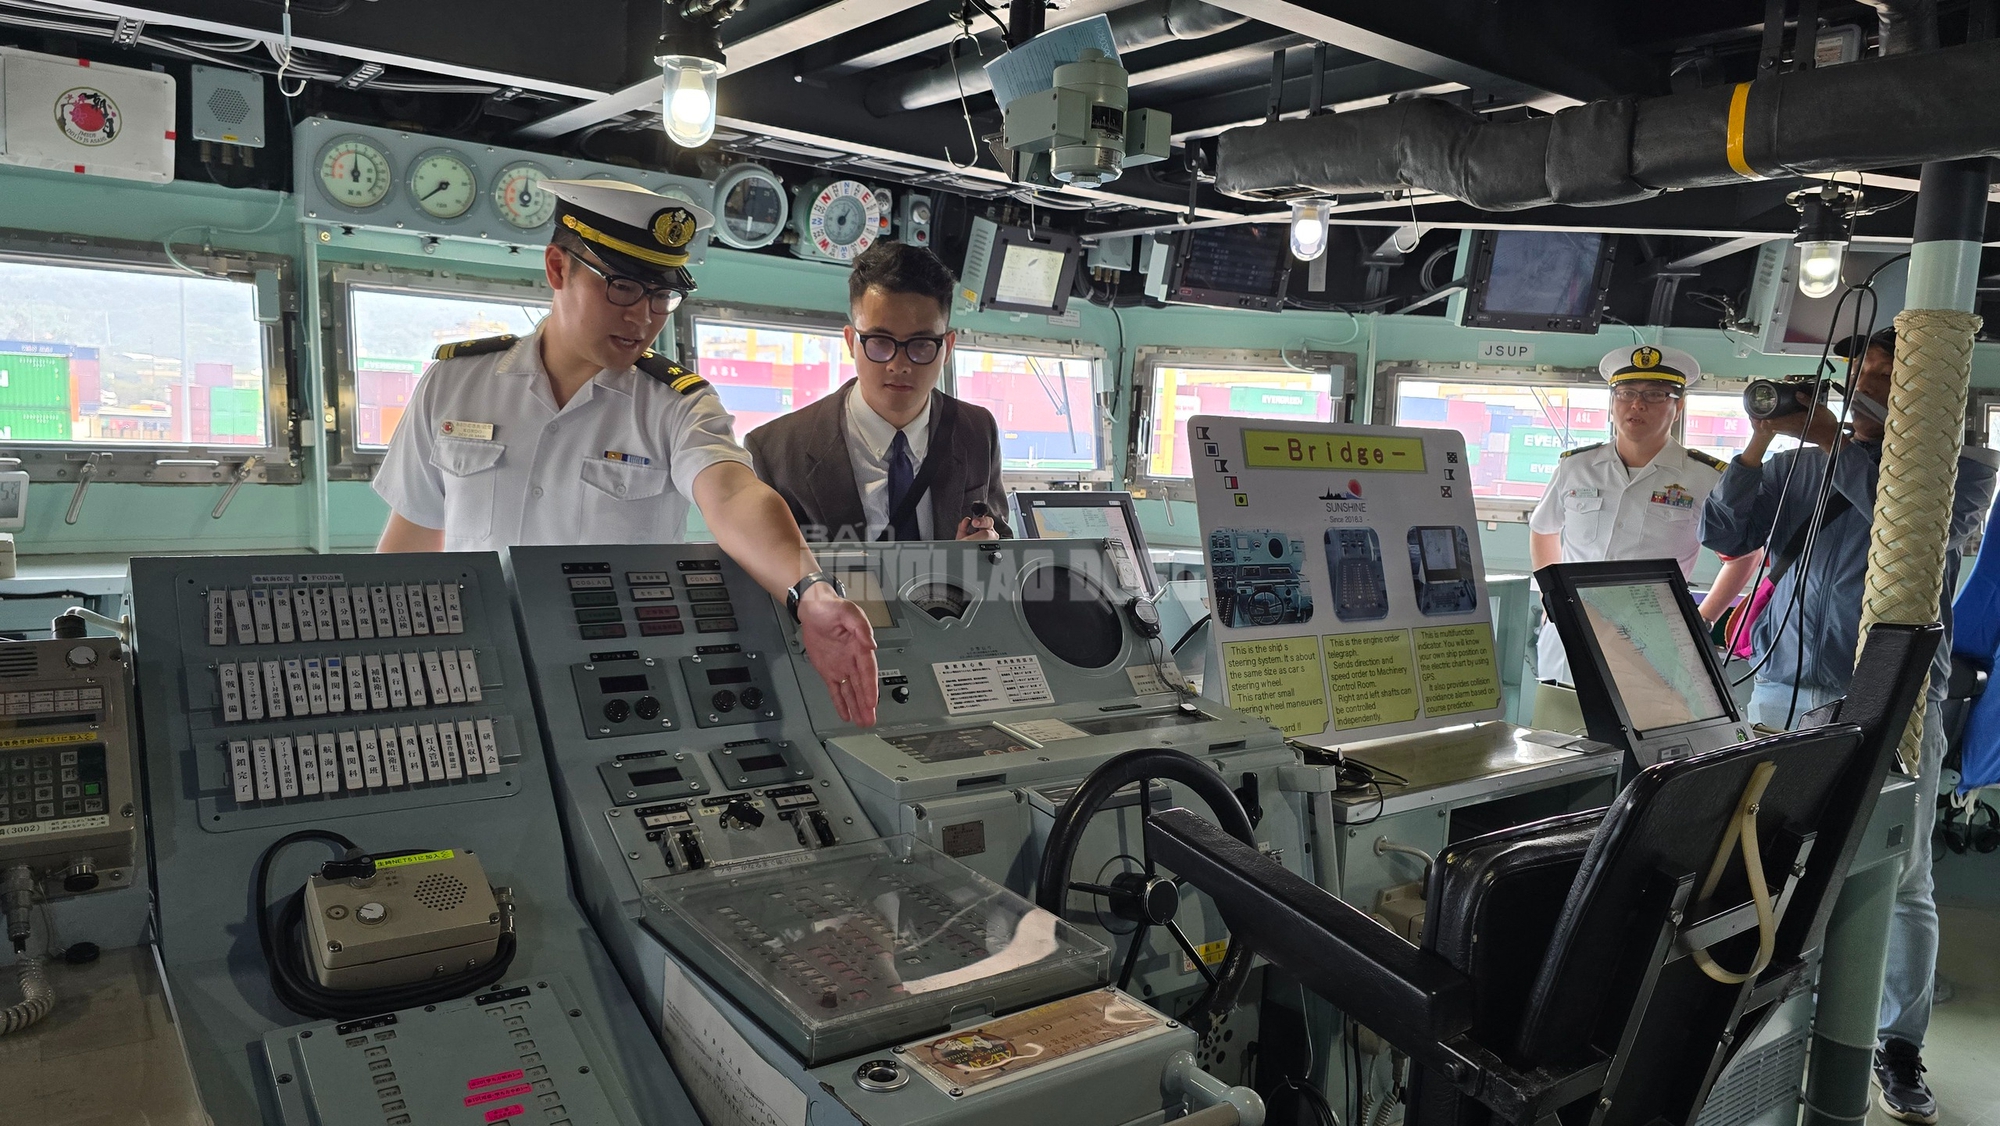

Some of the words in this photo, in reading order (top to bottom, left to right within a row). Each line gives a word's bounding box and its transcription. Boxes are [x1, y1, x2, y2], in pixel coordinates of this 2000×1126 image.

[820, 192, 831, 204] N
[861, 191, 871, 203] E
[818, 238, 830, 251] W
[859, 237, 869, 247] S
[1485, 345, 1528, 357] JSUP
[709, 365, 738, 377] ASL
[1262, 395, 1303, 405] EVERGREEN
[1575, 412, 1591, 423] ASL
[1724, 418, 1738, 431] ONE
[1326, 502, 1366, 513] SUNSHINE
[257, 600, 270, 630] 中部
[278, 599, 290, 629] 後部
[301, 599, 312, 628] 1分隊
[319, 599, 330, 628] 2分隊
[340, 597, 350, 626] 3分隊
[357, 597, 369, 626] 4分隊
[378, 596, 389, 625] 5分隊
[396, 595, 408, 629] FOD点検
[1330, 638, 1344, 647] This
[1345, 638, 1351, 646] is
[1351, 637, 1362, 645] the
[1363, 636, 1383, 646] engine
[1384, 634, 1400, 642] order
[1421, 631, 1434, 639] This
[1440, 628, 1475, 637] multifunction
[1230, 646, 1247, 655] This
[1248, 645, 1254, 654] is
[1255, 645, 1267, 653] the
[1417, 642, 1441, 650] indicator.
[1228, 658, 1257, 668] steering
[1258, 657, 1282, 666] system.
[1296, 652, 1316, 661] about
[1328, 648, 1359, 660] telegraph.
[1419, 654, 1432, 662] your
[1446, 650, 1458, 659] ship
[1458, 649, 1479, 657] position
[1333, 660, 1354, 669] Sends
[1354, 658, 1380, 668] direction
[1382, 656, 1393, 664] and
[1421, 663, 1431, 671] the
[1431, 661, 1451, 670] electric
[1452, 660, 1467, 668] chart
[1467, 659, 1474, 667] by
[1475, 658, 1489, 666] using
[1230, 670, 1242, 680] the
[1244, 669, 1263, 678] same
[1264, 667, 1277, 676] size
[1278, 667, 1287, 675] as
[1331, 671, 1350, 682] speed
[1351, 670, 1368, 679] order
[1369, 669, 1376, 677] to
[1376, 666, 1407, 676] Machinery
[290, 672, 304, 703] 船務科
[310, 671, 322, 702] 航海科
[330, 670, 341, 701] 機関科
[351, 669, 363, 700] 応急班
[371, 668, 384, 698] 補給衛生
[390, 666, 403, 696] 飛行科
[1232, 682, 1260, 692] steering
[1261, 678, 1283, 688] wheel.
[1332, 682, 1356, 692] Control
[1357, 681, 1377, 689] Room.
[1446, 680, 1469, 690] provides
[1470, 678, 1490, 686] collision
[1237, 693, 1254, 702] This
[1254, 691, 1276, 701] rather
[1278, 688, 1295, 698] small
[1338, 694, 1355, 704] Right
[1356, 692, 1369, 700] and
[1369, 690, 1380, 699] left
[1381, 688, 1400, 698] shafts
[1425, 693, 1454, 702] avoidance
[1471, 689, 1487, 697] based
[1264, 701, 1285, 711] wheel
[1286, 697, 1323, 709] maneuvers
[1336, 706, 1344, 715] be
[1345, 702, 1376, 713] controlled
[1427, 704, 1447, 713] course
[1447, 701, 1474, 711] prediction.
[1337, 712, 1381, 726] independently.
[0, 734, 84, 747] 者発生時NET51に加入
[406, 738, 419, 770] 飛行科
[425, 737, 440, 768] 灯火管制
[464, 734, 478, 763] 用具収め
[482, 733, 496, 764] 研究会
[323, 745, 335, 778] 航海科
[345, 745, 358, 778] 機関科
[366, 742, 378, 774] 応急班
[386, 740, 398, 772] 補給衛生
[303, 748, 315, 781] 船務科
[1027, 1023, 1052, 1036] DD
